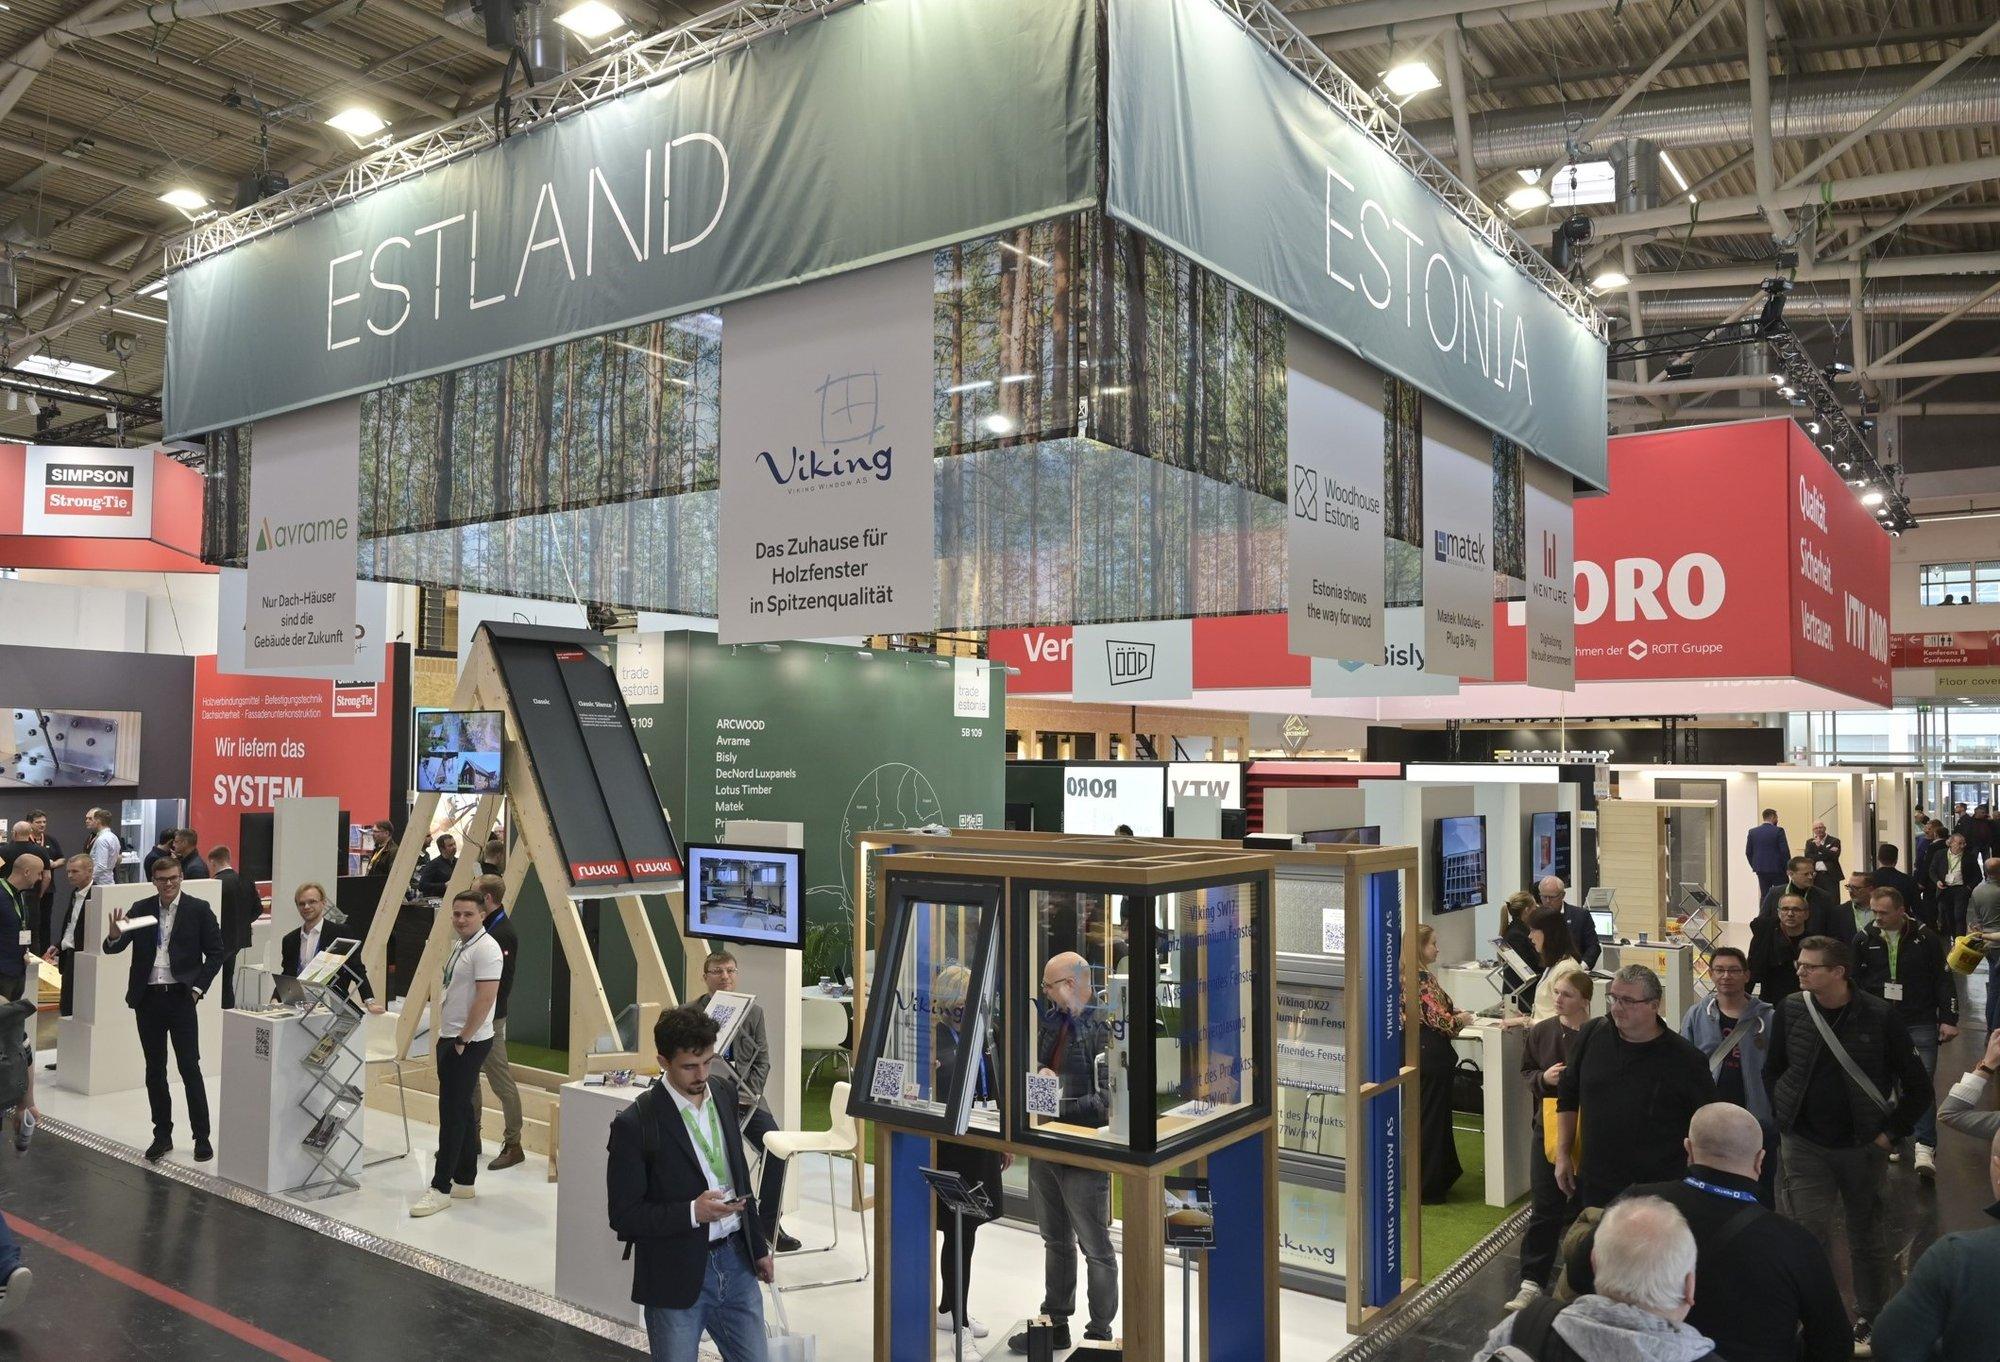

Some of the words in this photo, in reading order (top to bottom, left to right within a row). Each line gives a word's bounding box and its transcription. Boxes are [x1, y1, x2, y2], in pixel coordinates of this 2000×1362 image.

[325, 131, 731, 352] ESTLAND
[1325, 165, 1534, 407] ESTONIA
[755, 446, 892, 485] Viking
[51, 468, 129, 483] SIMPSON
[50, 494, 128, 511] Strong-Tie
[1324, 476, 1380, 514] Woodhouse
[1325, 502, 1360, 532] Estonia
[274, 517, 349, 548] avrame
[755, 542, 784, 560] Das
[788, 534, 859, 557] Zuhause
[862, 527, 888, 547] für
[1446, 532, 1486, 565] matek
[772, 560, 868, 585] Holzfenster
[1312, 579, 1343, 600] Estonia
[1343, 585, 1367, 604] shows
[1507, 552, 1726, 627] ORO
[262, 596, 277, 609] Nur
[278, 590, 337, 608] Dach-Häuser
[750, 597, 763, 614] in
[767, 585, 893, 616] Spitzenqualität
[281, 612, 299, 627] sind
[300, 611, 314, 625] die
[1307, 603, 1321, 620] the
[1322, 609, 1339, 626] way
[1339, 608, 1350, 625] for
[1351, 614, 1371, 628] wood
[1437, 608, 1456, 625] Matek
[1844, 590, 1866, 651] VTW
[1869, 607, 1888, 665] RORO
[254, 633, 291, 648] Gebäude
[292, 632, 307, 646] der
[307, 629, 344, 645] Zukunft
[1446, 630, 1459, 649] Plug
[1606, 645, 1624, 656] der
[1652, 643, 1679, 655] ROTT
[1681, 642, 1723, 656] Gruppe
[1923, 656, 1961, 664] Conference
[622, 666, 649, 679] trade
[1939, 678, 1967, 686] Floor
[621, 682, 658, 696] estonia
[336, 694, 373, 708] Strong-Tie
[638, 717, 653, 728] 109
[716, 719, 765, 730] ARCWOOD
[215, 737, 235, 757] Wir
[238, 737, 277, 758] liefern
[281, 737, 305, 758] das
[716, 735, 751, 746] Avrame
[716, 752, 737, 764] Bisly
[716, 768, 754, 779] DecNord
[755, 768, 796, 780] Luxpanels
[213, 773, 303, 807] SYSTEM
[715, 785, 740, 795] Lotus
[741, 784, 772, 795] Timber
[1171, 780, 1230, 800] VTW
[715, 801, 744, 811] Matek
[1385, 910, 1392, 928] AS
[1277, 996, 1305, 1010] Viking
[1307, 999, 1330, 1012] DK22
[1286, 1109, 1301, 1121] des
[1385, 1116, 1394, 1137] AS
[1386, 1143, 1395, 1214] WINDOW
[1386, 1217, 1395, 1274] VIKING
